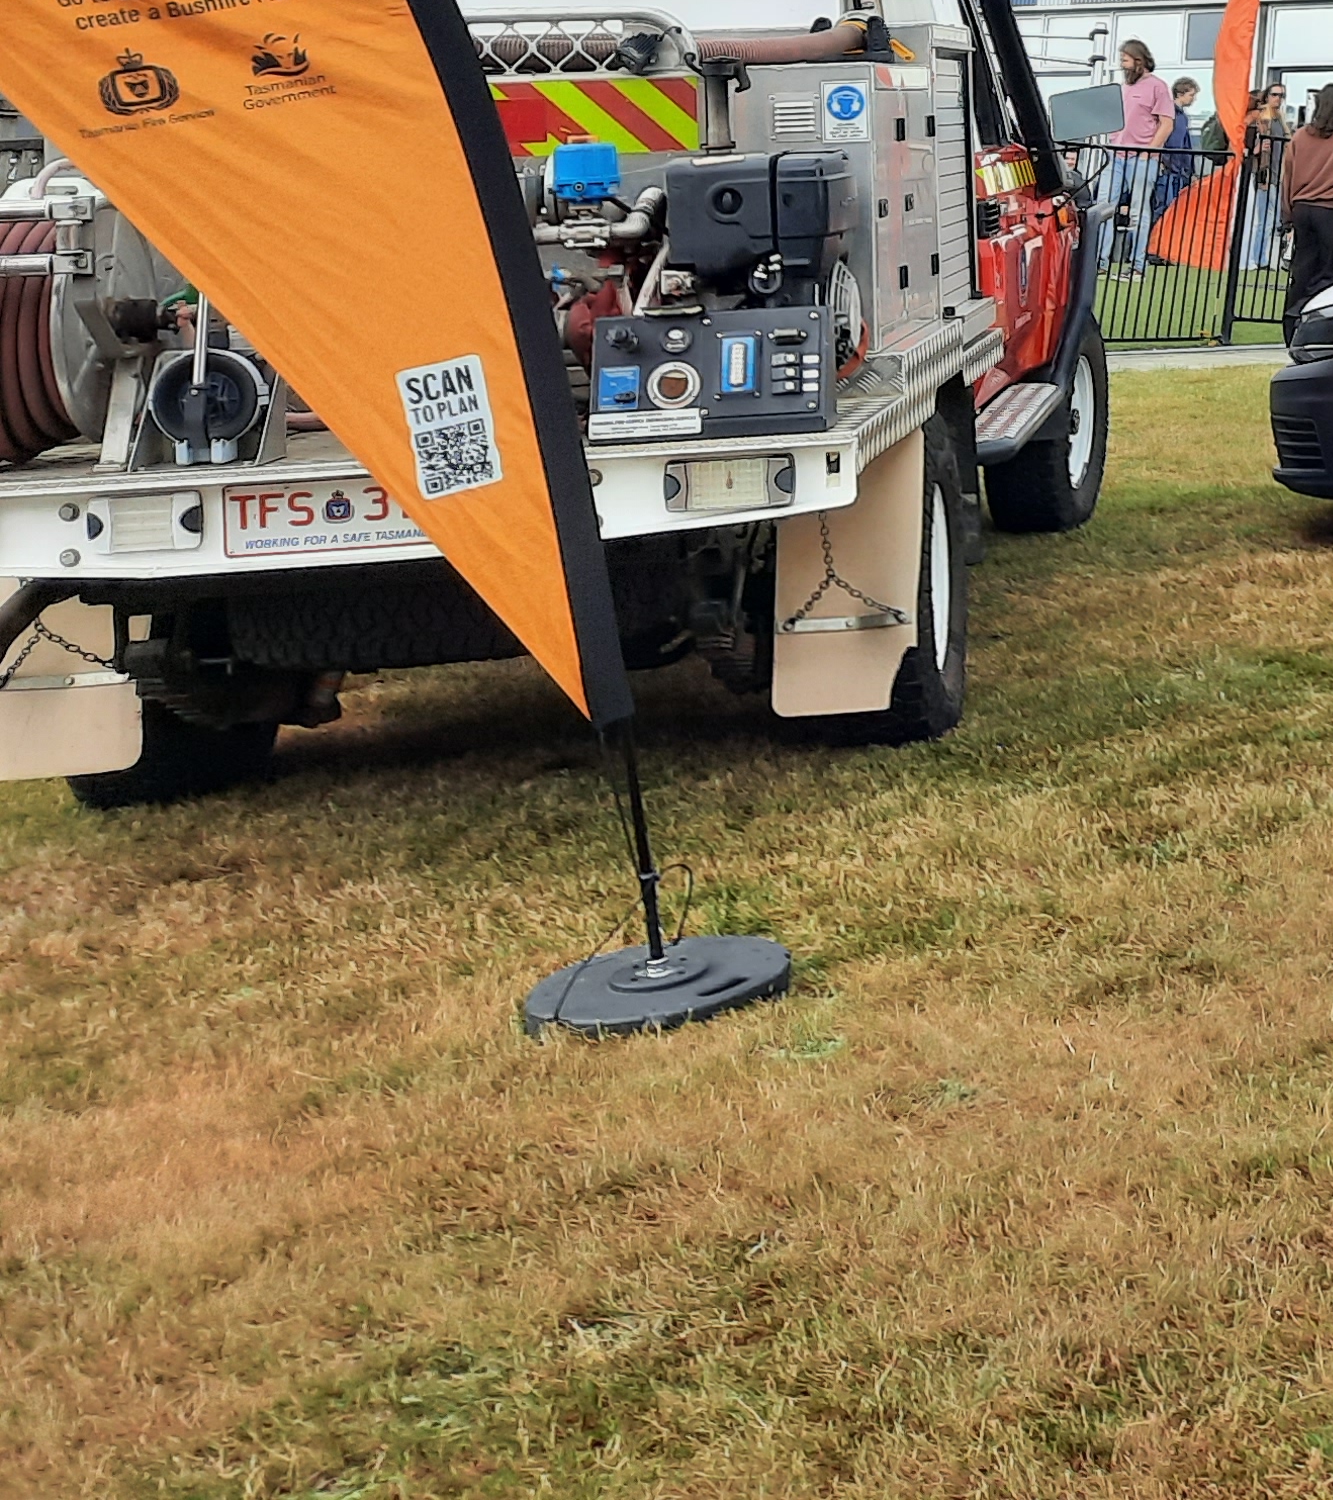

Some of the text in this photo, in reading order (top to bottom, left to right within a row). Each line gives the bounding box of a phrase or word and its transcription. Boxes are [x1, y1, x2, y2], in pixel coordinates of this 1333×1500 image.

[75, 6, 141, 30] create
[147, 6, 160, 19] a
[245, 73, 326, 94] Tasmanian
[243, 84, 337, 110] Government
[79, 121, 139, 138] Tasmania
[405, 364, 474, 405] SCAN
[409, 394, 480, 426] TO PLAN
[229, 486, 410, 530] TFS 3
[245, 536, 299, 550] WORKING
[304, 535, 327, 546] FOR
[330, 534, 339, 544] A
[342, 532, 371, 543] SAFE
